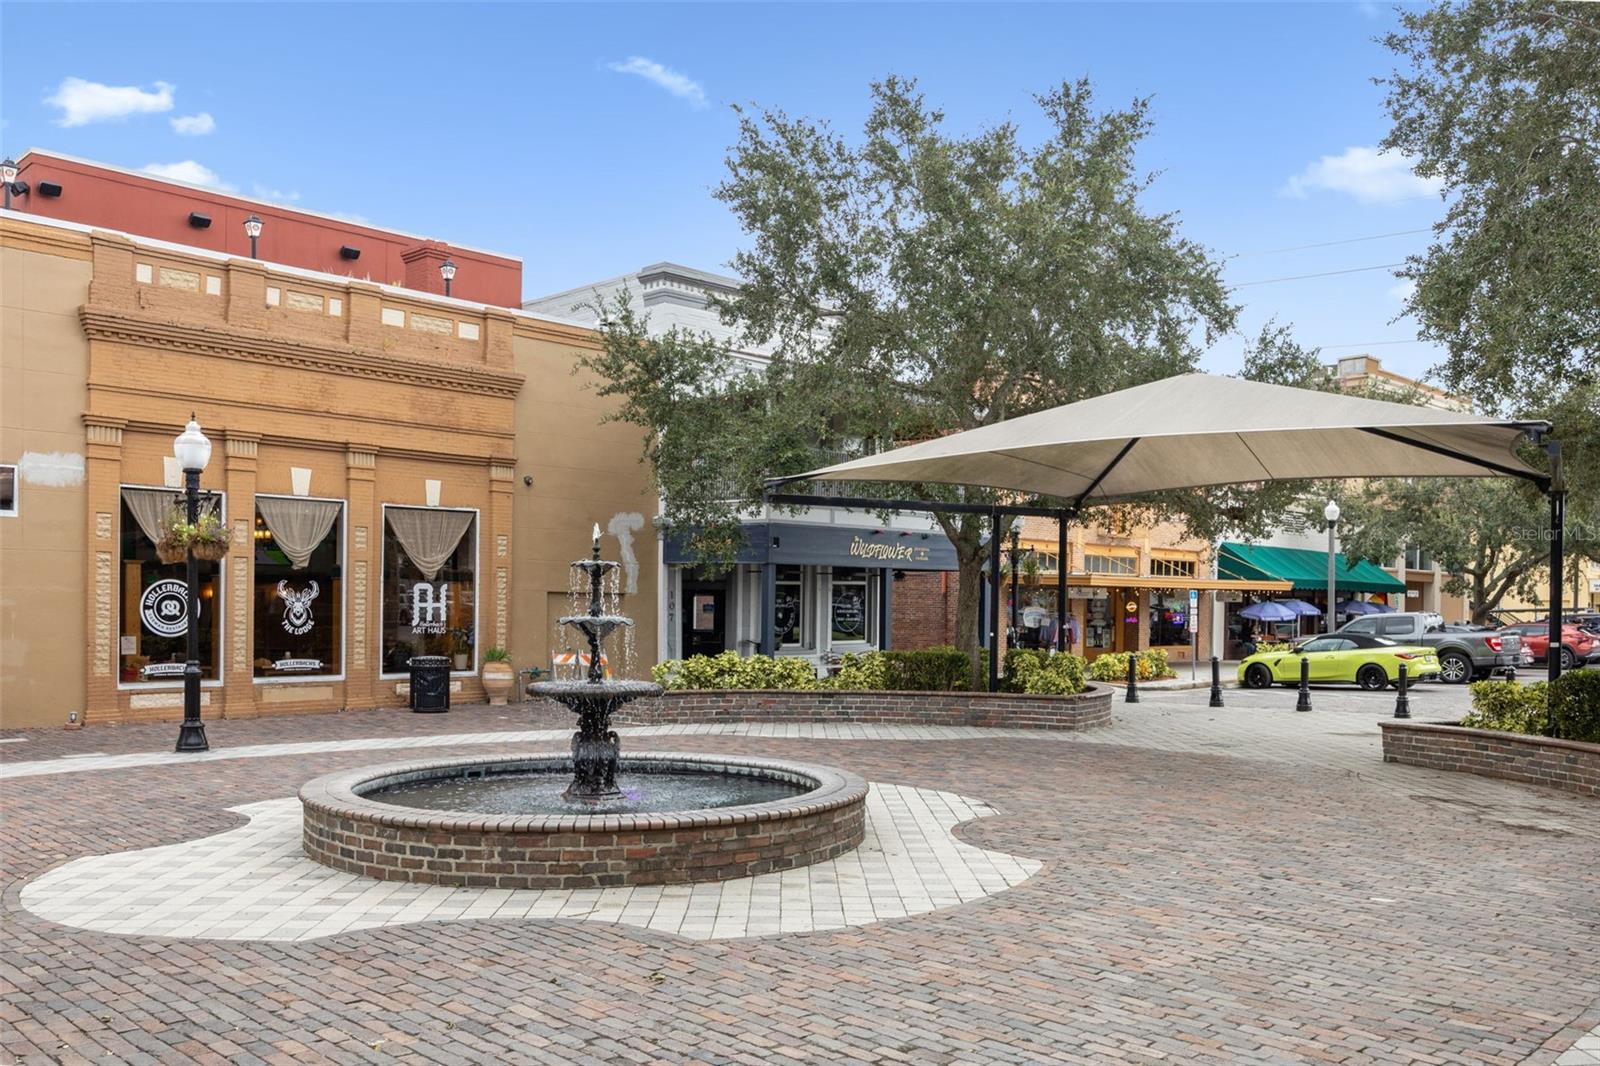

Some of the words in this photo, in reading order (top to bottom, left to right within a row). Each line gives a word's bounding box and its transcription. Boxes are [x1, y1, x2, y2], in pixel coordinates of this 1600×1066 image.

[145, 583, 188, 606] HOLLERBAC
[281, 619, 295, 634] THE
[294, 619, 315, 635] LODGE
[411, 626, 426, 635] ART
[427, 626, 447, 635] HAUS
